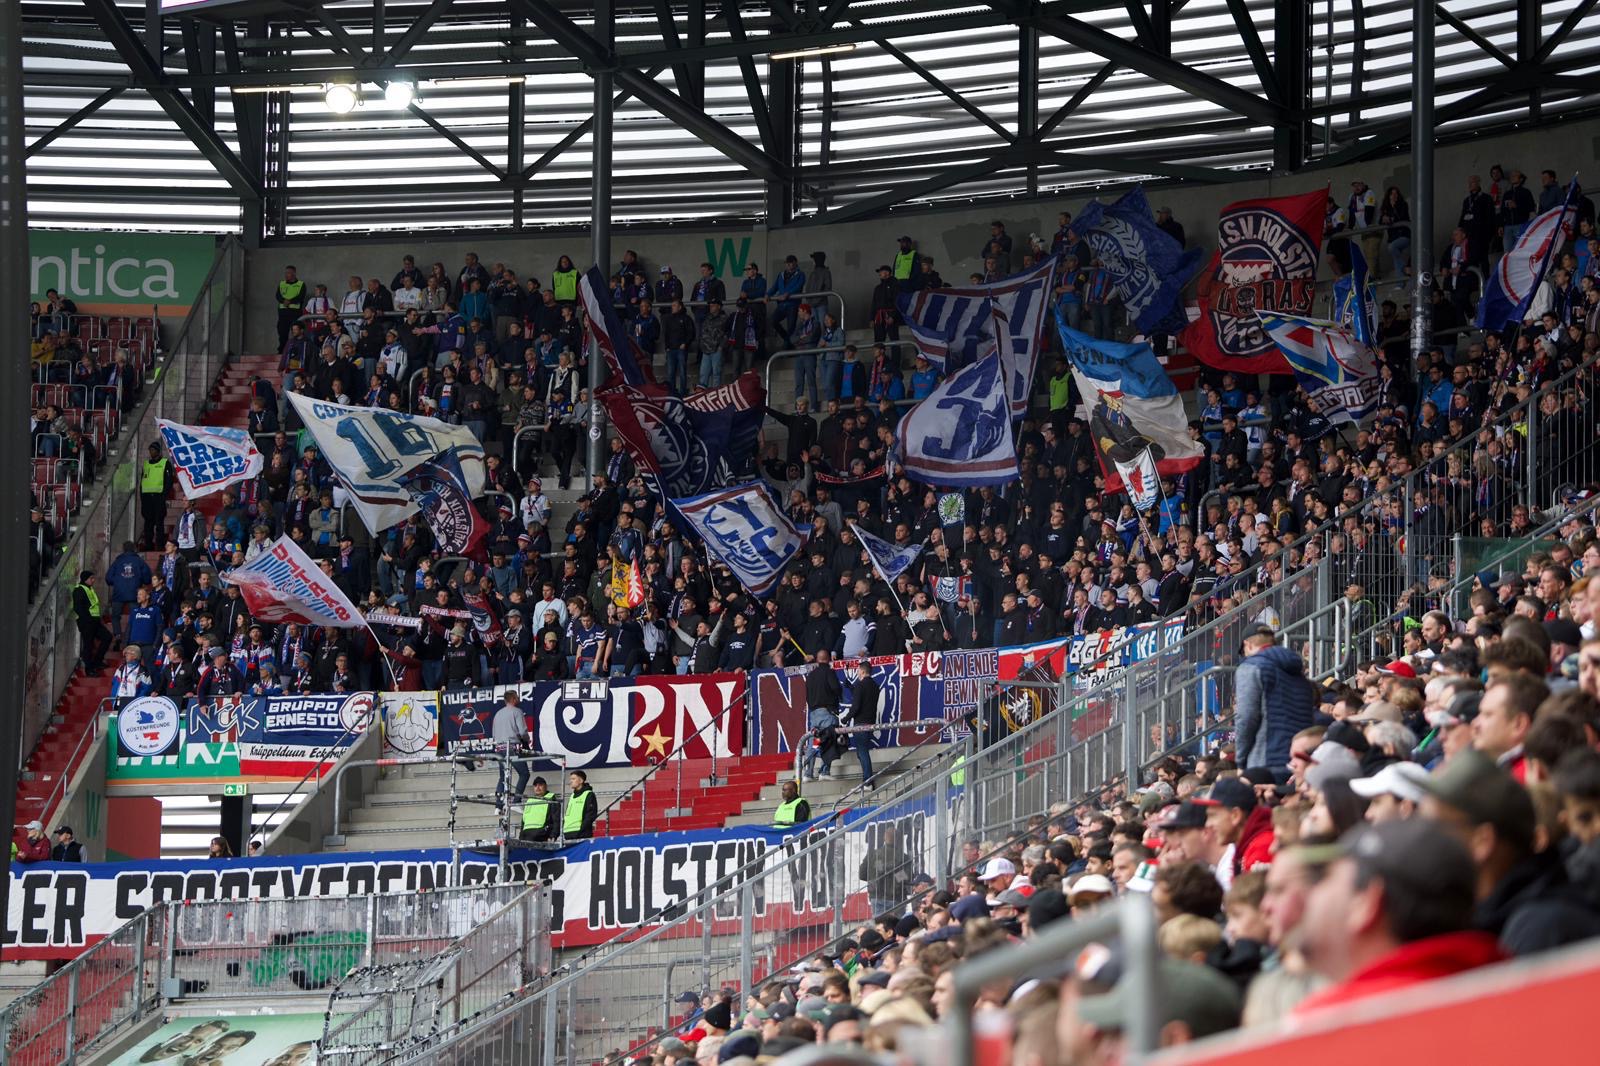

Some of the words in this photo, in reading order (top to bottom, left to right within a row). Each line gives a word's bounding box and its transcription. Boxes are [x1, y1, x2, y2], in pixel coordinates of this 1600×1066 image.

[704, 237, 752, 277] W
[31, 245, 179, 299] ntica
[188, 455, 245, 485] KIEL
[944, 654, 965, 679] AM
[966, 651, 998, 678] ENDE
[266, 712, 339, 728] ERNESTO
[268, 700, 338, 713] GRUPPO
[250, 746, 306, 760] Knüppelduun
[589, 839, 766, 928] HOLSTEIN
